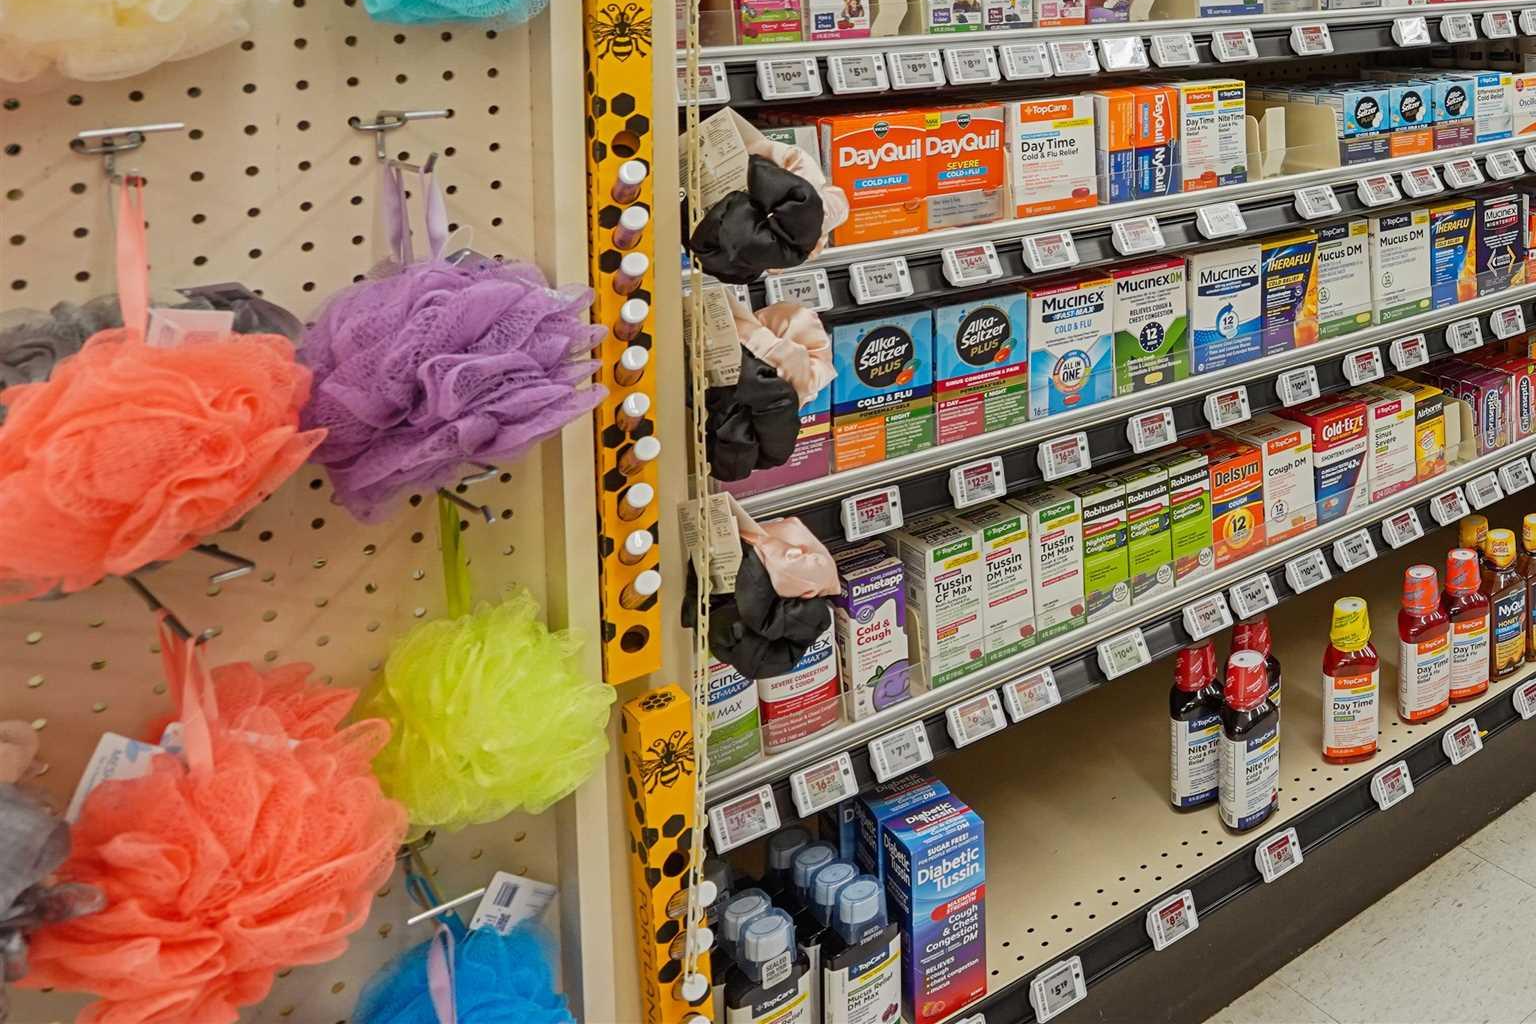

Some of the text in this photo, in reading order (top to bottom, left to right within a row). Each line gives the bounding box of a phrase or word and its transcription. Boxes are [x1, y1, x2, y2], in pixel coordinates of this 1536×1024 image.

[1032, 104, 1069, 115] TopCare
[1152, 94, 1165, 144] DayQuil
[926, 130, 1000, 158] DayQuil
[1021, 137, 1075, 153] Day Time
[839, 139, 922, 170] DayQuil
[1022, 153, 1038, 161] Cold
[1047, 150, 1057, 159] Flu
[1059, 148, 1078, 157] Relief
[947, 159, 980, 170] SEVERE
[1152, 147, 1165, 193] NyQuil
[1485, 206, 1517, 221] Mucinex
[1380, 229, 1424, 247] Mucus DM
[1267, 251, 1311, 272] THERAFLU
[1200, 264, 1256, 284] Mucinex
[1042, 290, 1104, 314] Mucinex
[966, 316, 999, 334] Alka-
[1222, 317, 1234, 325] 12
[961, 322, 1006, 348] Seltzer
[1147, 329, 1158, 340] 12
[864, 336, 901, 356] Alka-
[970, 338, 999, 357] PLUS
[860, 343, 909, 370] Seltzer
[1062, 360, 1081, 371] ALL IN
[870, 358, 901, 379] PLUS
[1062, 367, 1081, 381] ONE
[857, 389, 913, 408] COLD & FLU
[1416, 401, 1443, 418] Airborne
[1214, 461, 1259, 488] Delsym
[1268, 457, 1307, 477] Cough DM
[1128, 484, 1167, 505] Robitussin
[1083, 499, 1125, 519] Robitussin
[1232, 518, 1247, 531] 12
[986, 553, 1022, 572] Tussin
[986, 563, 1023, 582] DM Max
[852, 574, 903, 596] Dimetapp
[935, 574, 972, 593] Tussin
[856, 618, 890, 637] Cold &
[856, 629, 892, 646] Cough
[1343, 678, 1369, 687] TopCare
[1333, 698, 1373, 711] Day Time
[918, 846, 980, 887] Diabetic
[934, 863, 981, 892] Tussin
[949, 904, 978, 924] Cough
[926, 923, 979, 953] Congestion
[963, 932, 978, 946] DM
